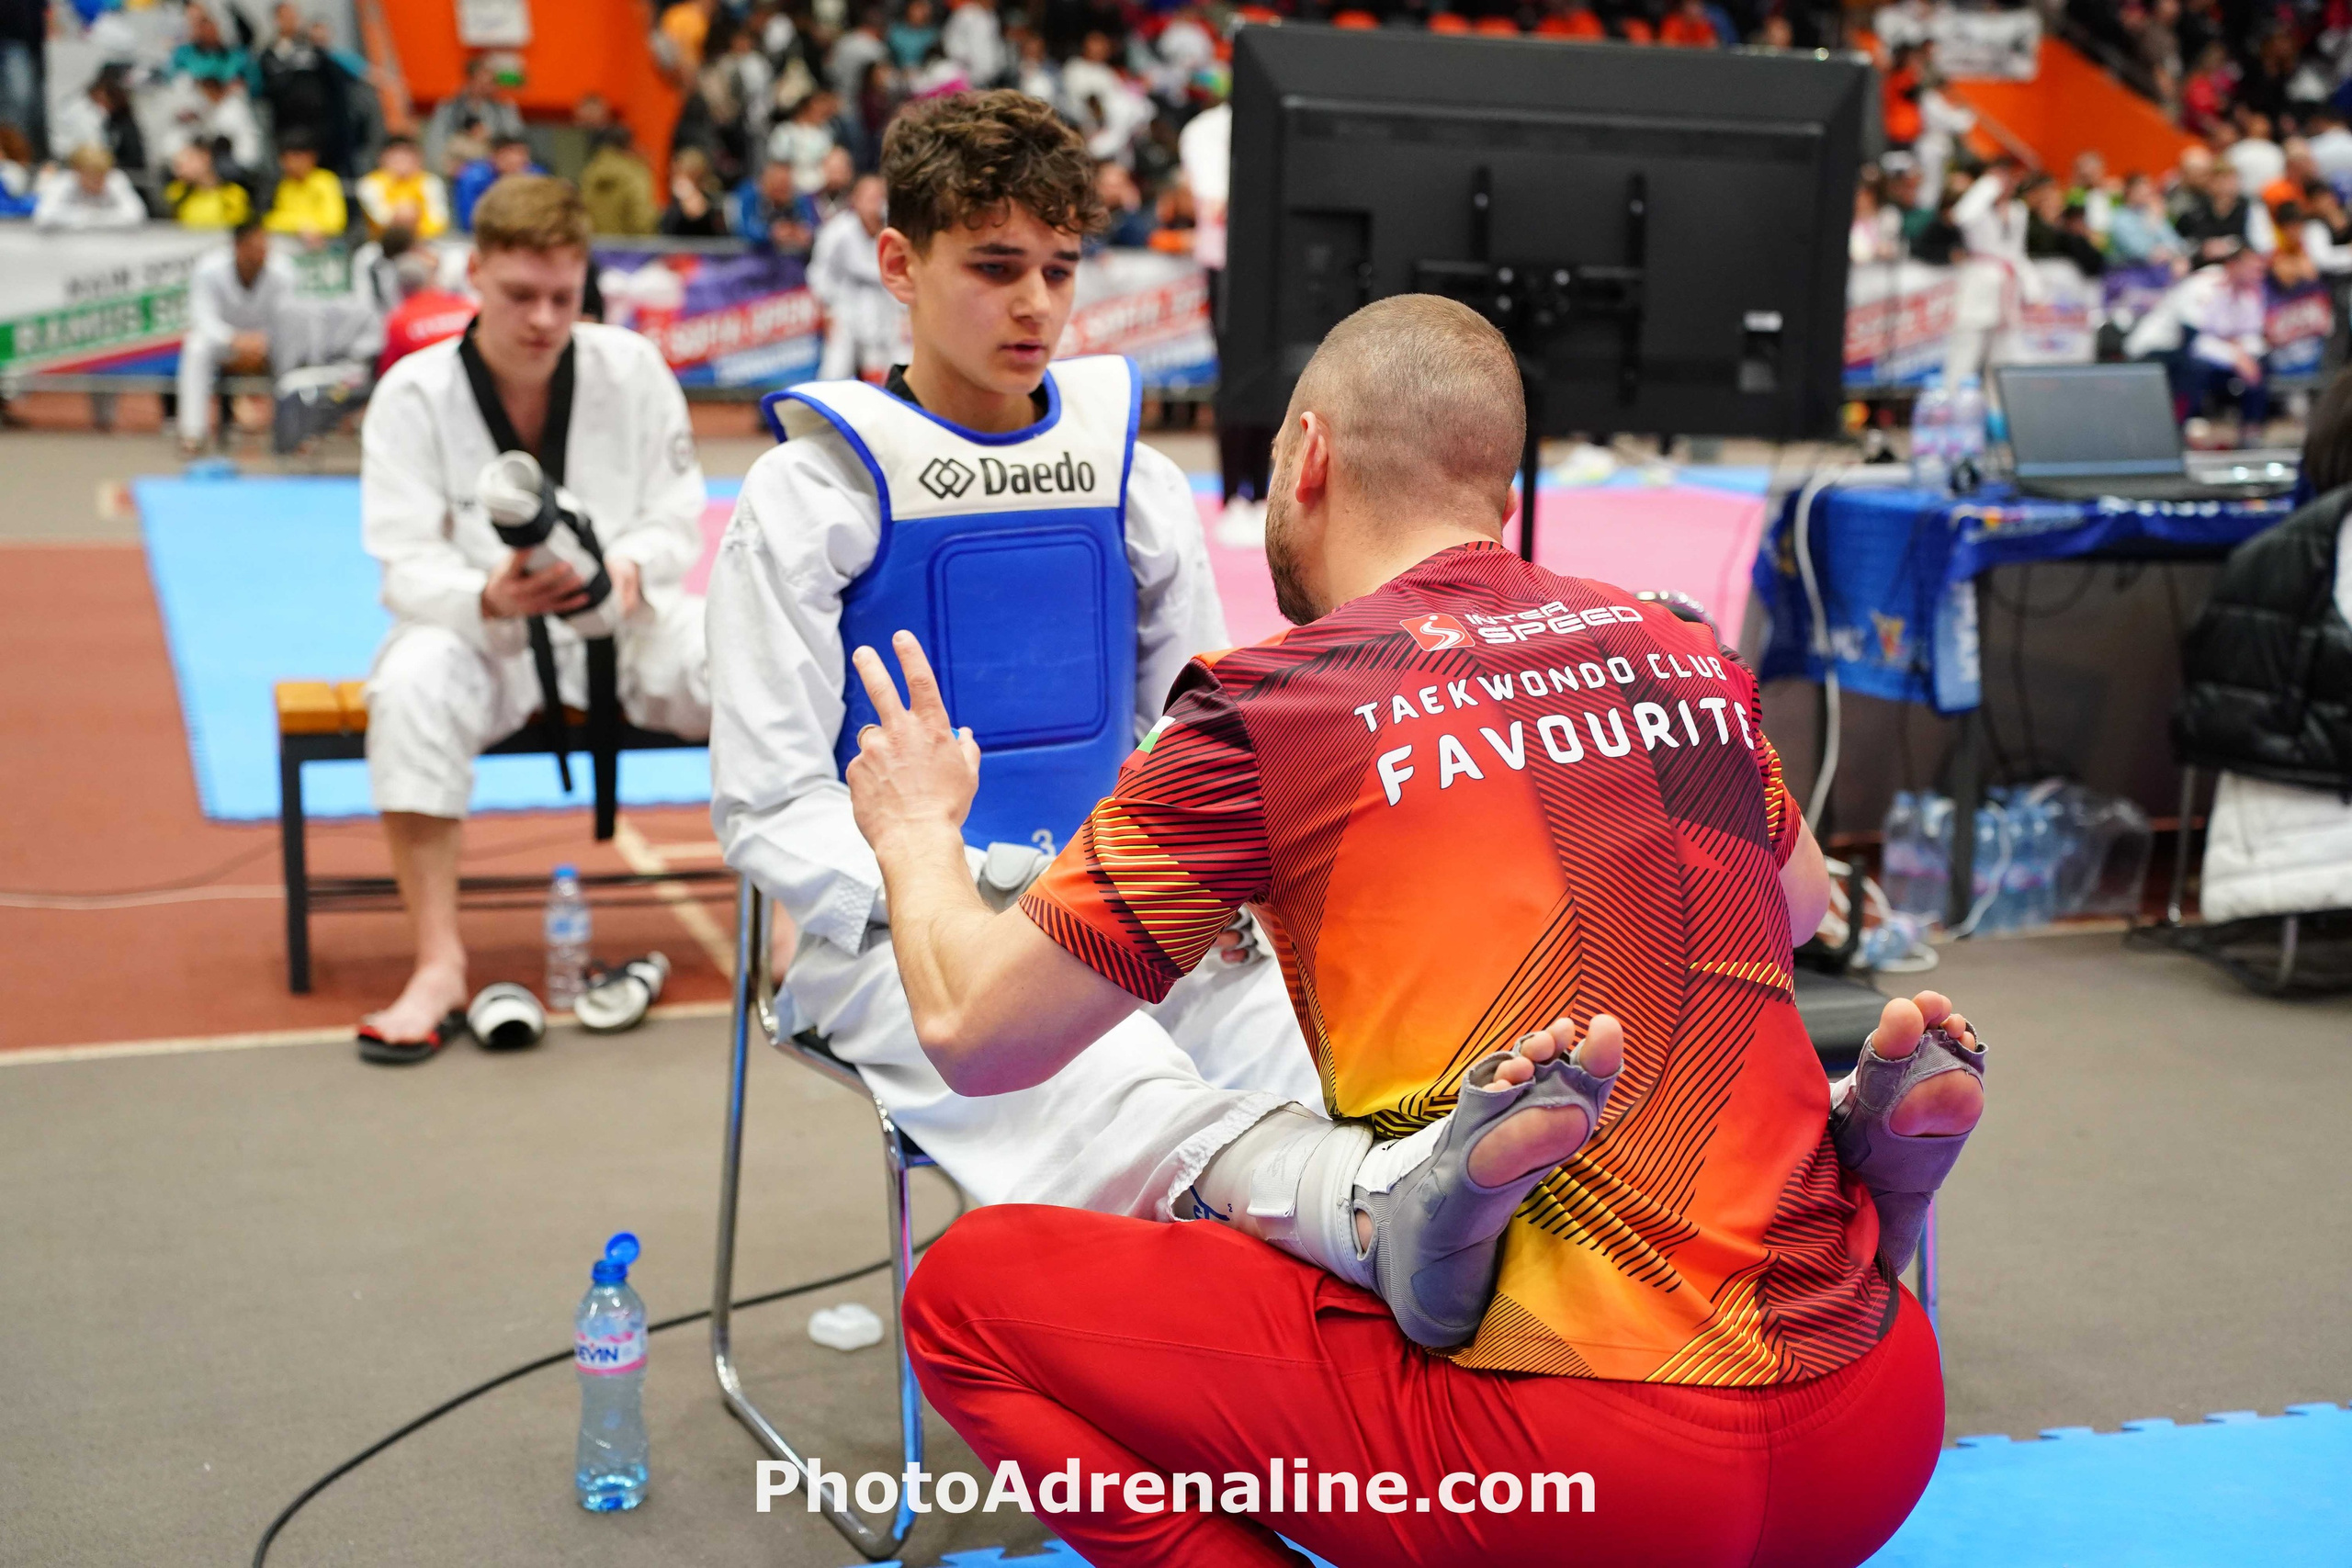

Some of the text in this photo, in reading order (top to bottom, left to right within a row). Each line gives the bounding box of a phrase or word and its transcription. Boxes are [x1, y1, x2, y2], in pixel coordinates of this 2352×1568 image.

[978, 450, 1095, 496] Daedo
[1464, 601, 1569, 626] INTER
[1477, 605, 1644, 644] SPEED
[1354, 652, 1728, 734] TAEKWONDO CLUB
[1376, 696, 1755, 807] FAVOURITE
[1031, 828, 1057, 857] 3
